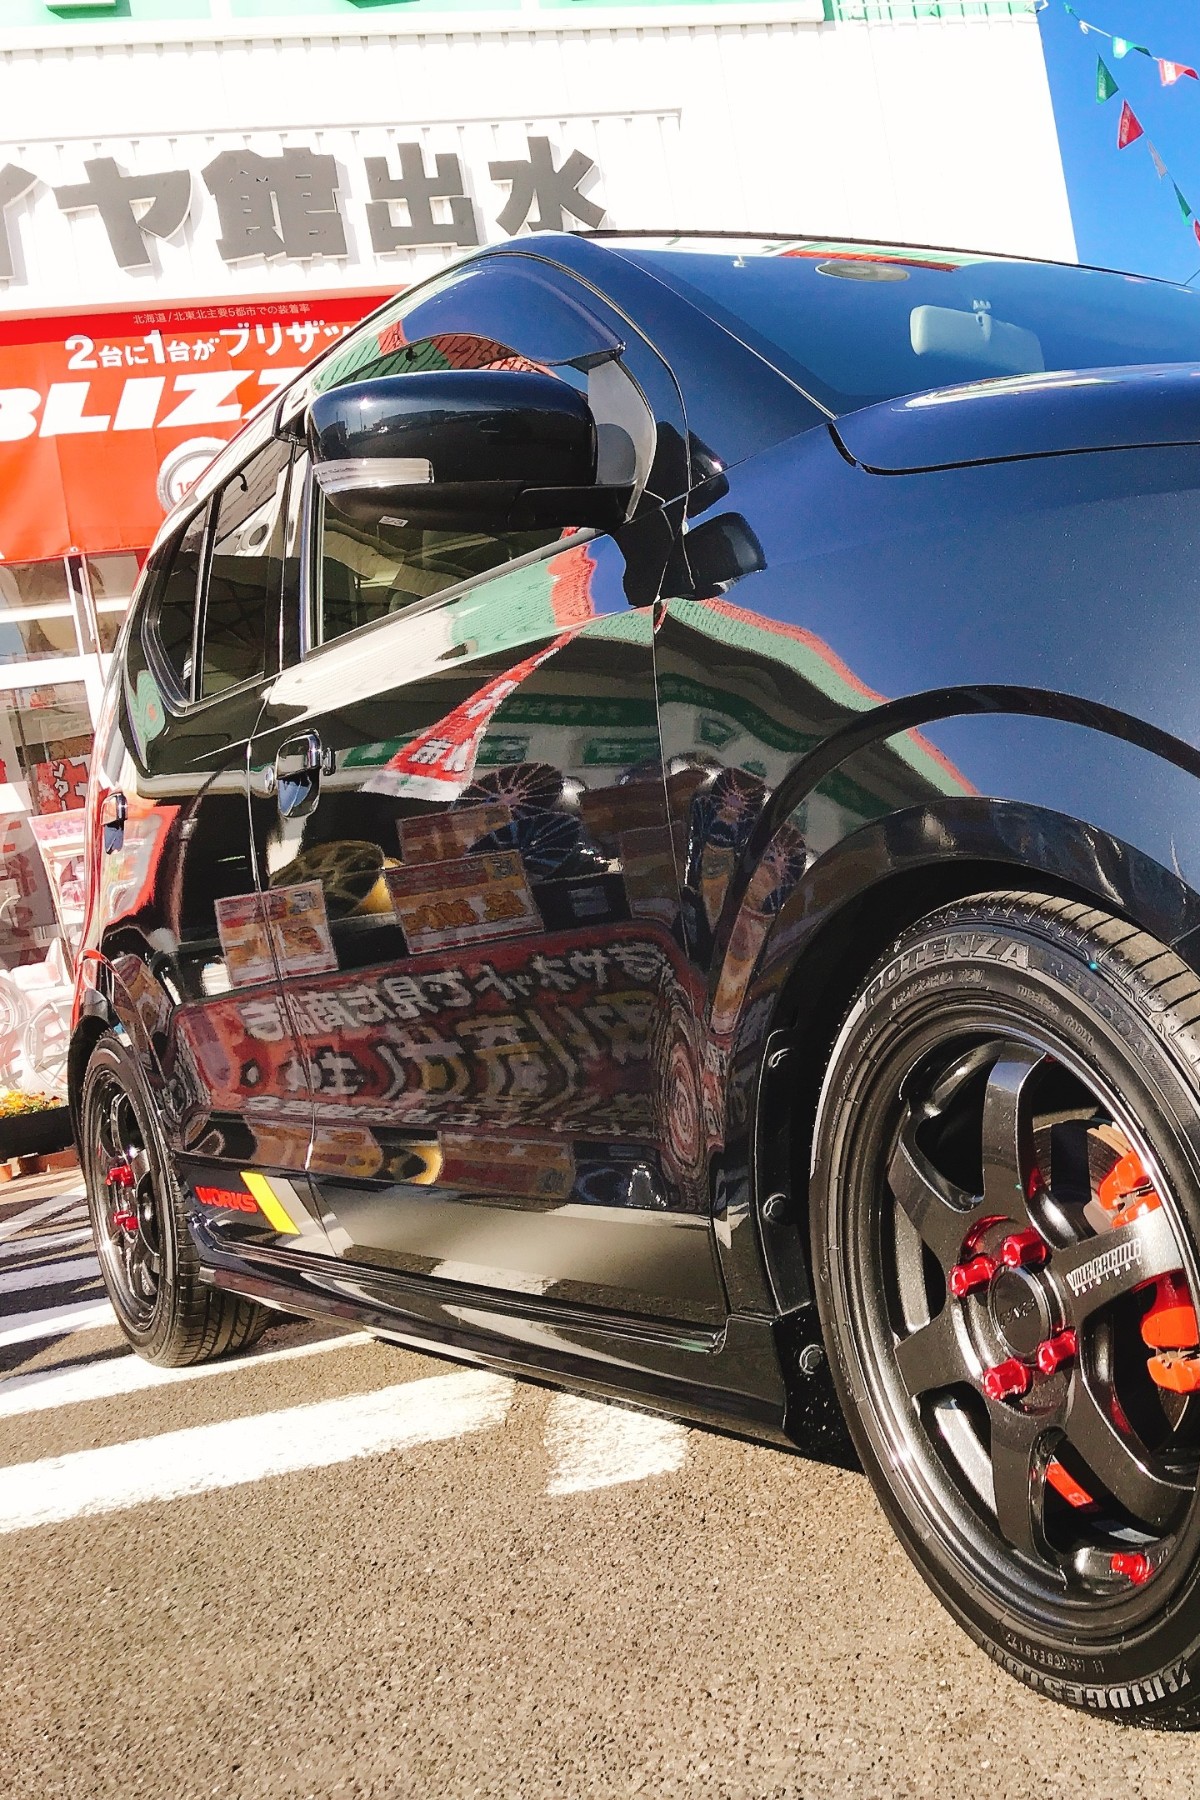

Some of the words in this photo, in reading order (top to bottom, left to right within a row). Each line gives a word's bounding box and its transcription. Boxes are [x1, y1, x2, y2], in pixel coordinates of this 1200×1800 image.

[862, 933, 1032, 1013] POTENZA
[1063, 1015, 1096, 1047] RADIAL
[195, 1185, 258, 1213] WORKS
